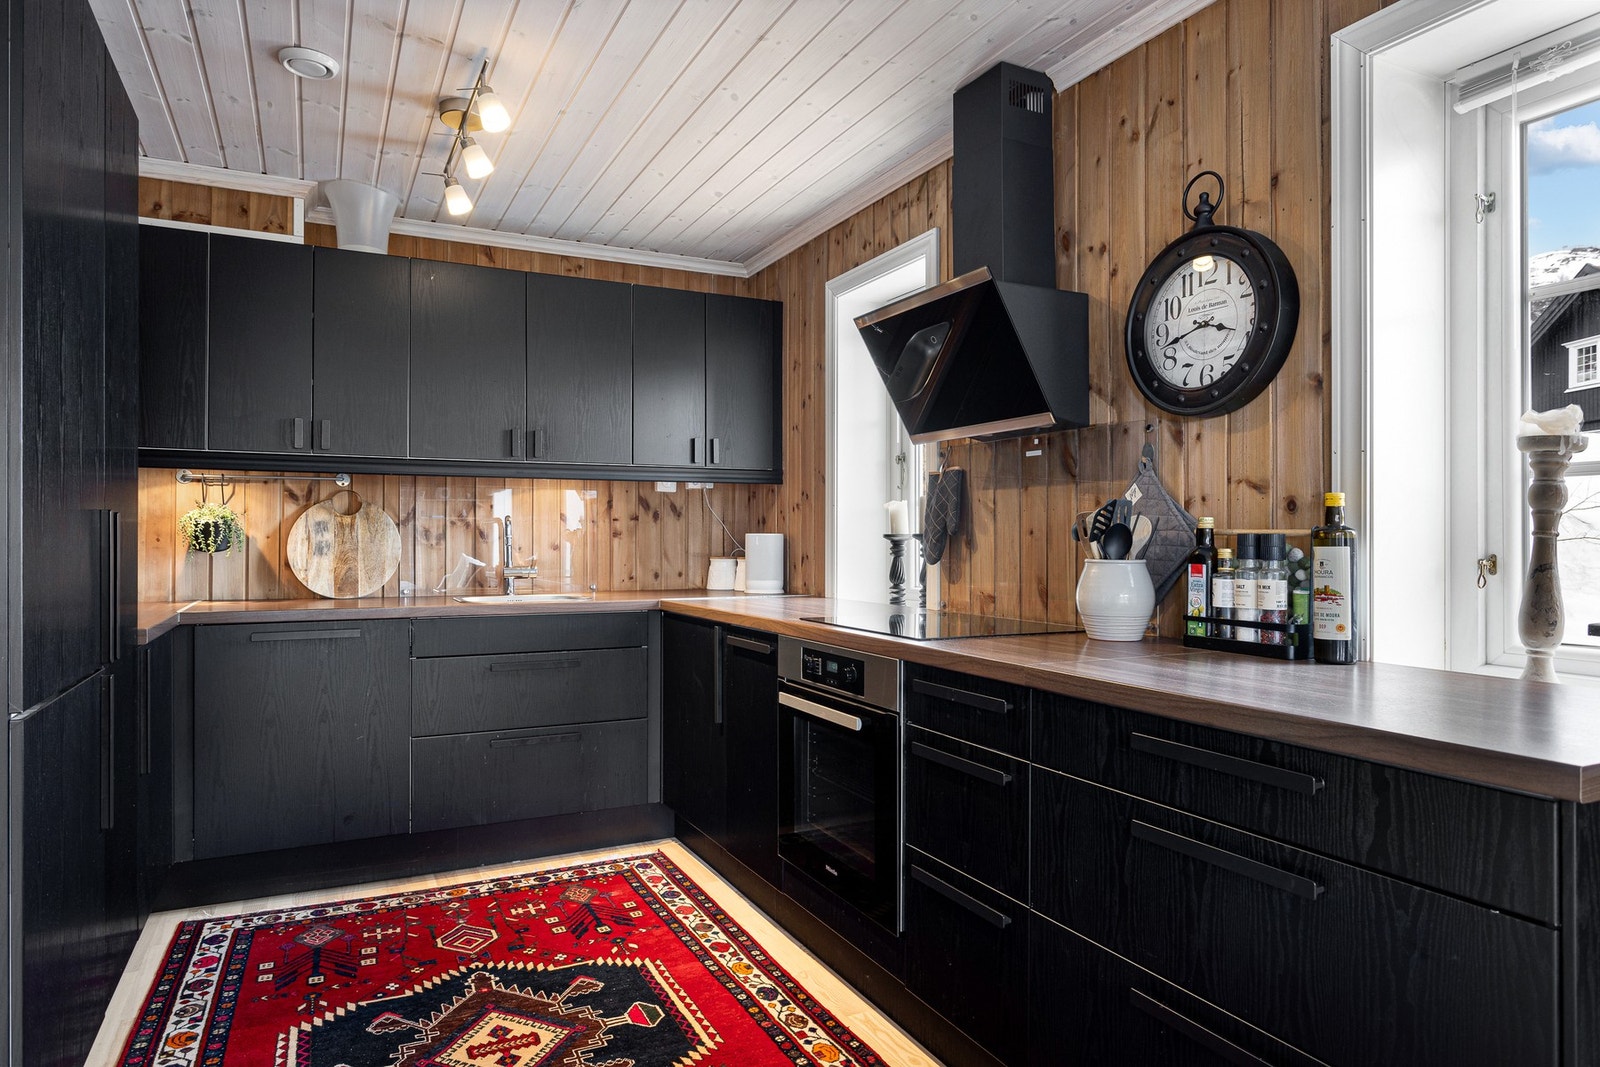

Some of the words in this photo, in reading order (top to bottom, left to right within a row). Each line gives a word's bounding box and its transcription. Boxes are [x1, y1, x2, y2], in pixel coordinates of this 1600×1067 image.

[1181, 271, 1194, 299] 11
[1238, 272, 1253, 299] 2
[1163, 296, 1182, 322] 10
[1155, 323, 1170, 348] 9
[1163, 346, 1178, 372] 8
[1181, 363, 1194, 387] 7
[1199, 363, 1214, 386] 6
